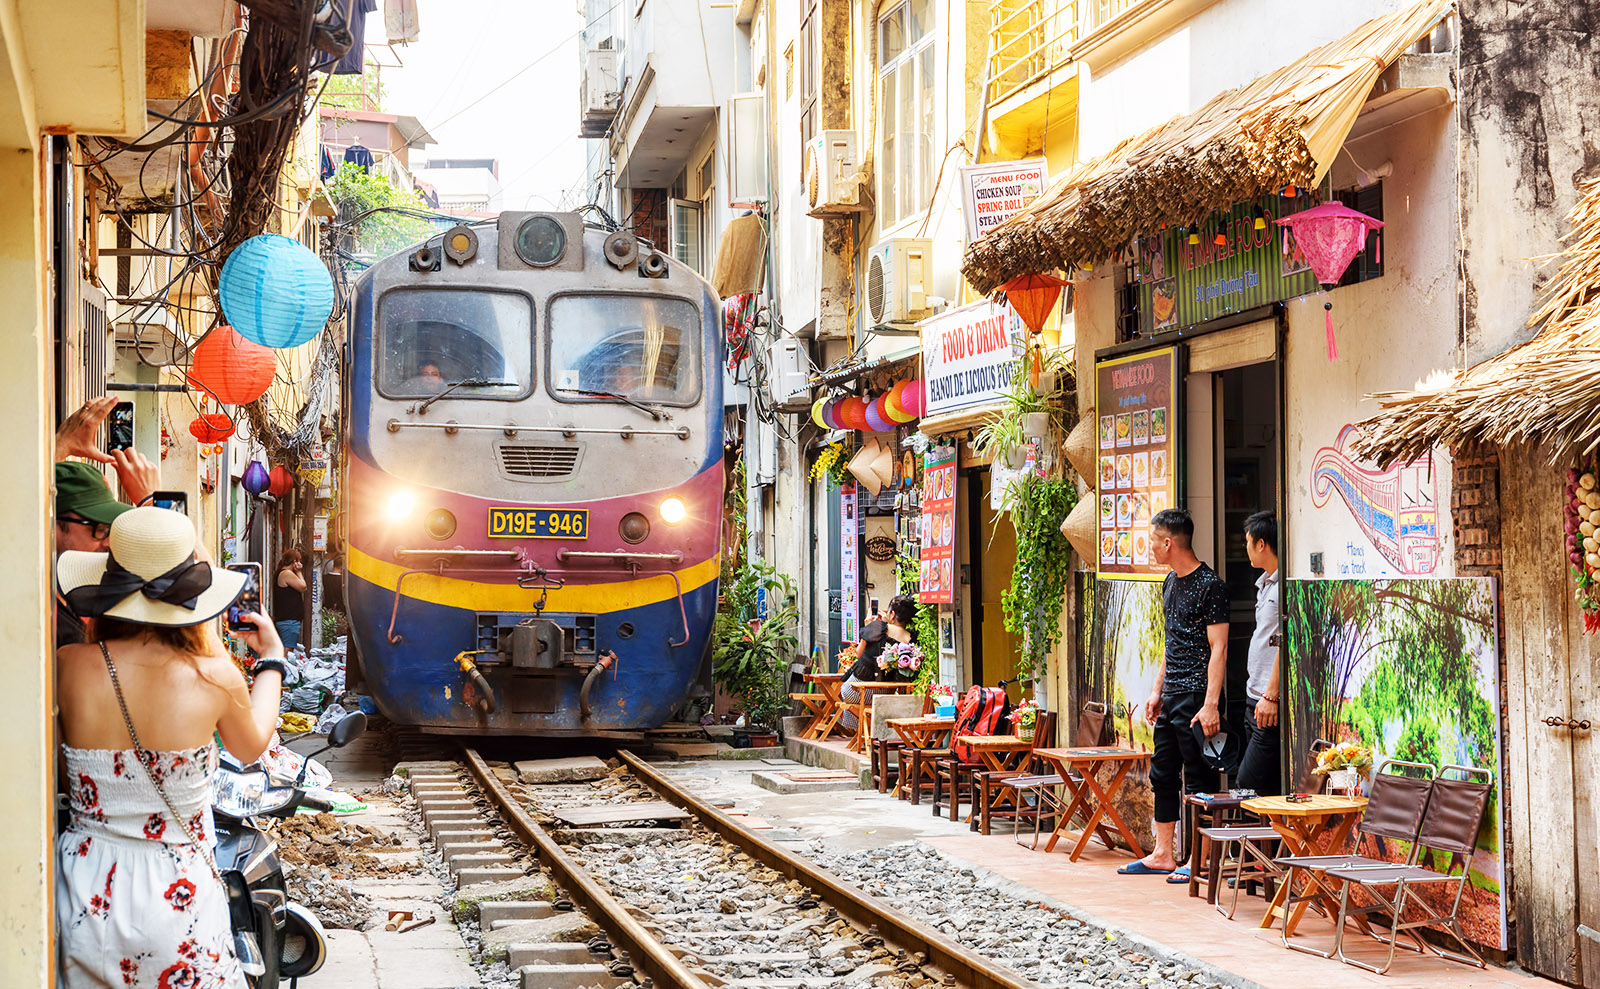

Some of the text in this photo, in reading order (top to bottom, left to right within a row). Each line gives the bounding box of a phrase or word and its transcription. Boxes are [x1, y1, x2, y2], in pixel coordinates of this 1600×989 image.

[990, 175, 1014, 184] MENU
[1015, 172, 1040, 181] FOOD
[976, 185, 1022, 200] CHICKEN SOUP
[977, 199, 1022, 214] SPRING ROLL
[979, 214, 1003, 227] STEAM
[1235, 209, 1273, 255] FOOD
[1196, 284, 1205, 303] 30
[941, 327, 965, 364] FOOD
[966, 324, 974, 357] &
[975, 314, 1008, 355] DRINK
[930, 374, 953, 403] HANOI
[953, 372, 965, 397] DE
[964, 364, 996, 395] LICIOUS
